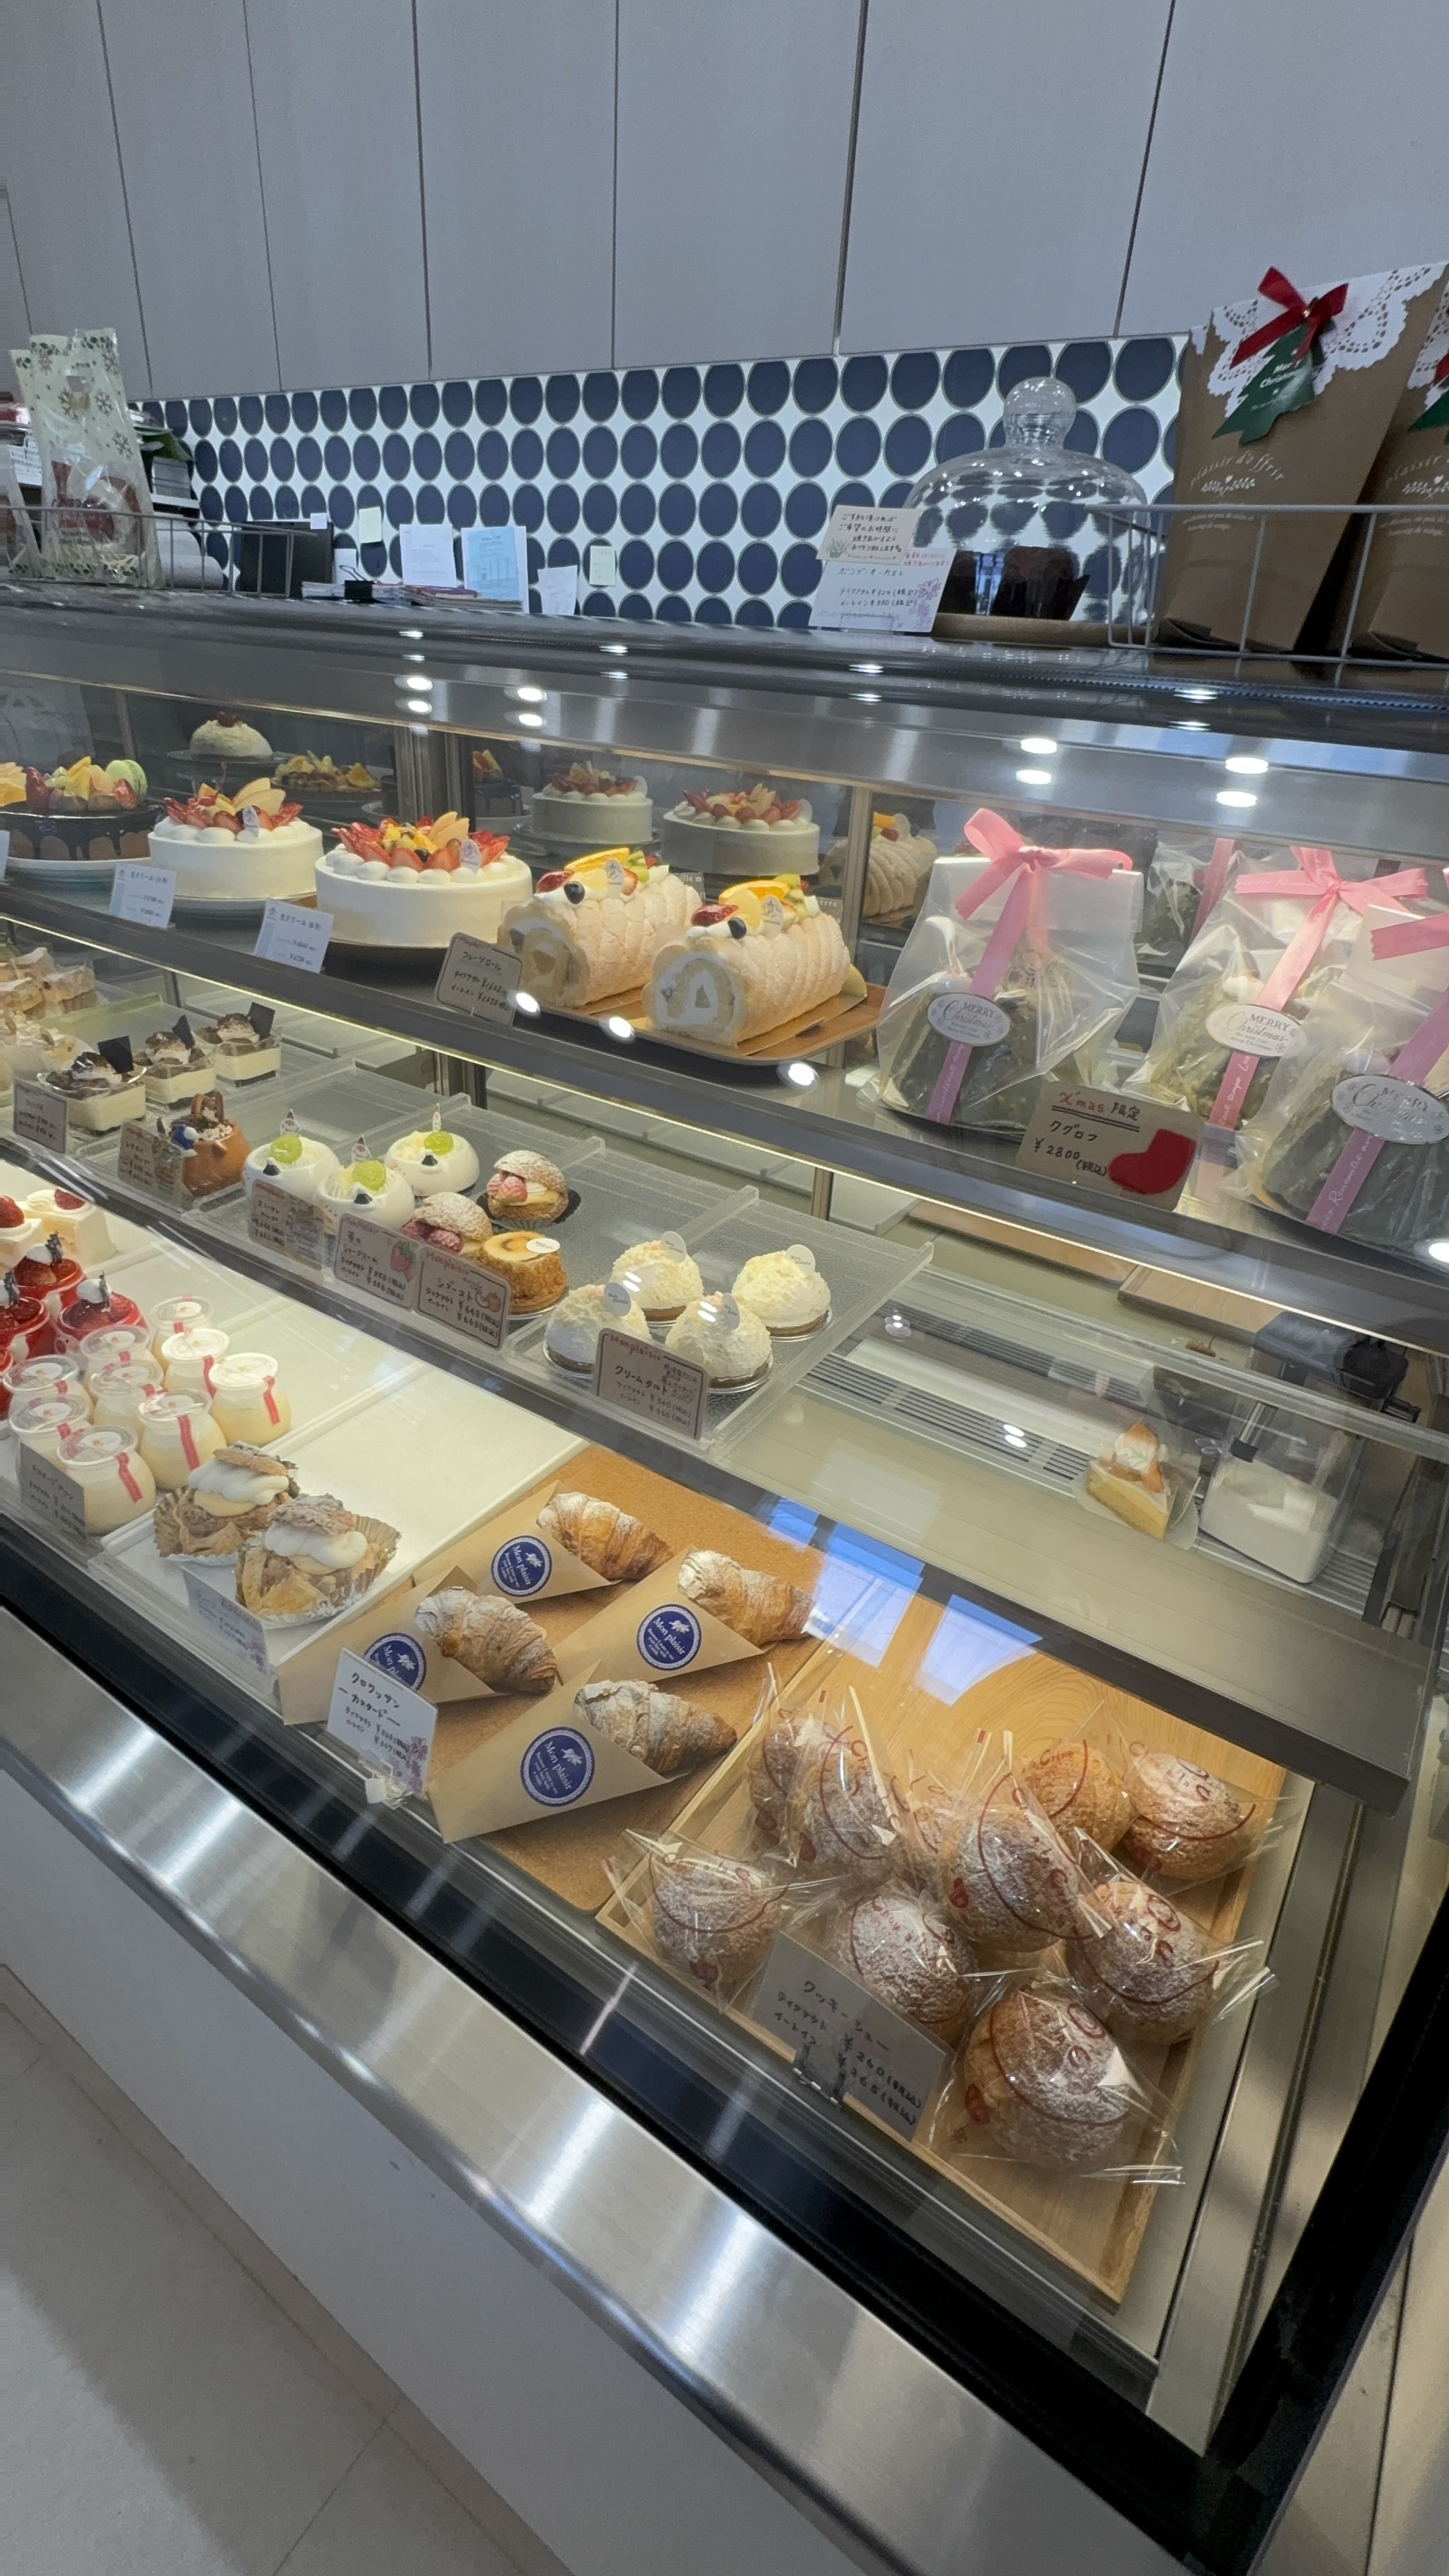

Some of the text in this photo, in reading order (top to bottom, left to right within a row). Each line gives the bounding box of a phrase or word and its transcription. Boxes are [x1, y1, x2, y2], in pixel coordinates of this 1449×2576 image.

[962, 1001, 996, 1019] MERRY
[1227, 1011, 1289, 1041] Christmas
[1249, 1013, 1290, 1031] MERRY
[1110, 1101, 1141, 1121] 限定
[1049, 1120, 1098, 1142] クグロフ
[513, 1545, 533, 1586] Mon plaisir
[653, 1617, 668, 1636] Mon
[664, 1633, 686, 1655] plaisir
[383, 1644, 394, 1666] Mon
[351, 1671, 400, 1708] クロワッサン
[544, 1740, 558, 1764] Mon
[551, 1763, 572, 1790] plaisir
[777, 1991, 828, 2032] テイクアウト
[803, 1980, 890, 2051] クッキーシュー
[774, 2012, 817, 2046] イートイン
